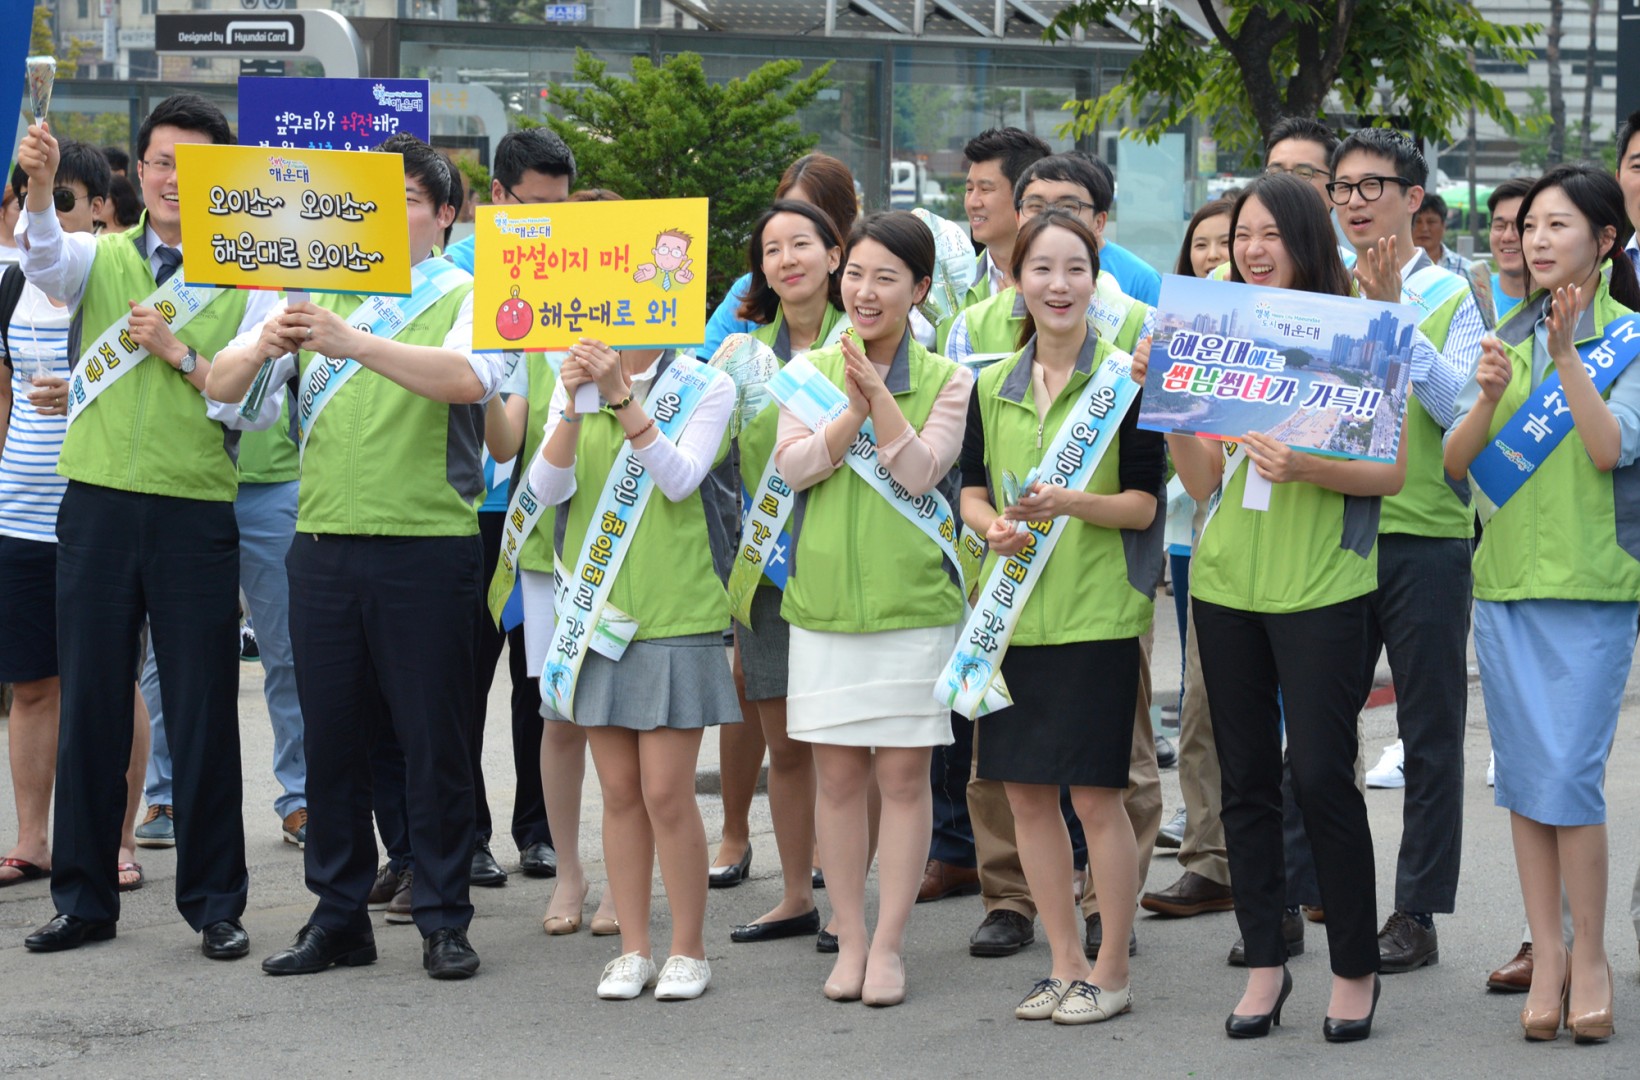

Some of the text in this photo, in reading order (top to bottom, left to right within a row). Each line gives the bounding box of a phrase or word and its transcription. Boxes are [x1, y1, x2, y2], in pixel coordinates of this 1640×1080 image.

[178, 32, 286, 44] Designed by Hyundai Card
[391, 99, 423, 111] 해운대
[275, 111, 399, 137] 옆구리가 허전해?
[269, 167, 310, 183] 해운대
[208, 185, 377, 221] 오이소~ 오이소~
[514, 225, 551, 238] 해운대
[211, 231, 384, 272] 해운대로 오이소~
[503, 243, 629, 280] 망설이지 마!
[173, 278, 199, 312] 해운대
[373, 296, 402, 330] 해운대
[538, 298, 677, 332] 해운대로 와!
[1278, 323, 1321, 340] 해운대
[85, 342, 120, 383] 지금
[1168, 330, 1286, 371] 해운대에는
[670, 367, 707, 391] 해운대
[1107, 359, 1133, 379] 해운
[656, 391, 681, 423] 올
[1089, 386, 1116, 420] 올
[1163, 364, 1383, 418] 썸남썸녀가 가득!!
[743, 520, 772, 564] 간다
[574, 511, 627, 611] 해운대로
[557, 617, 585, 659] 가자
[970, 609, 1005, 653] 가자
